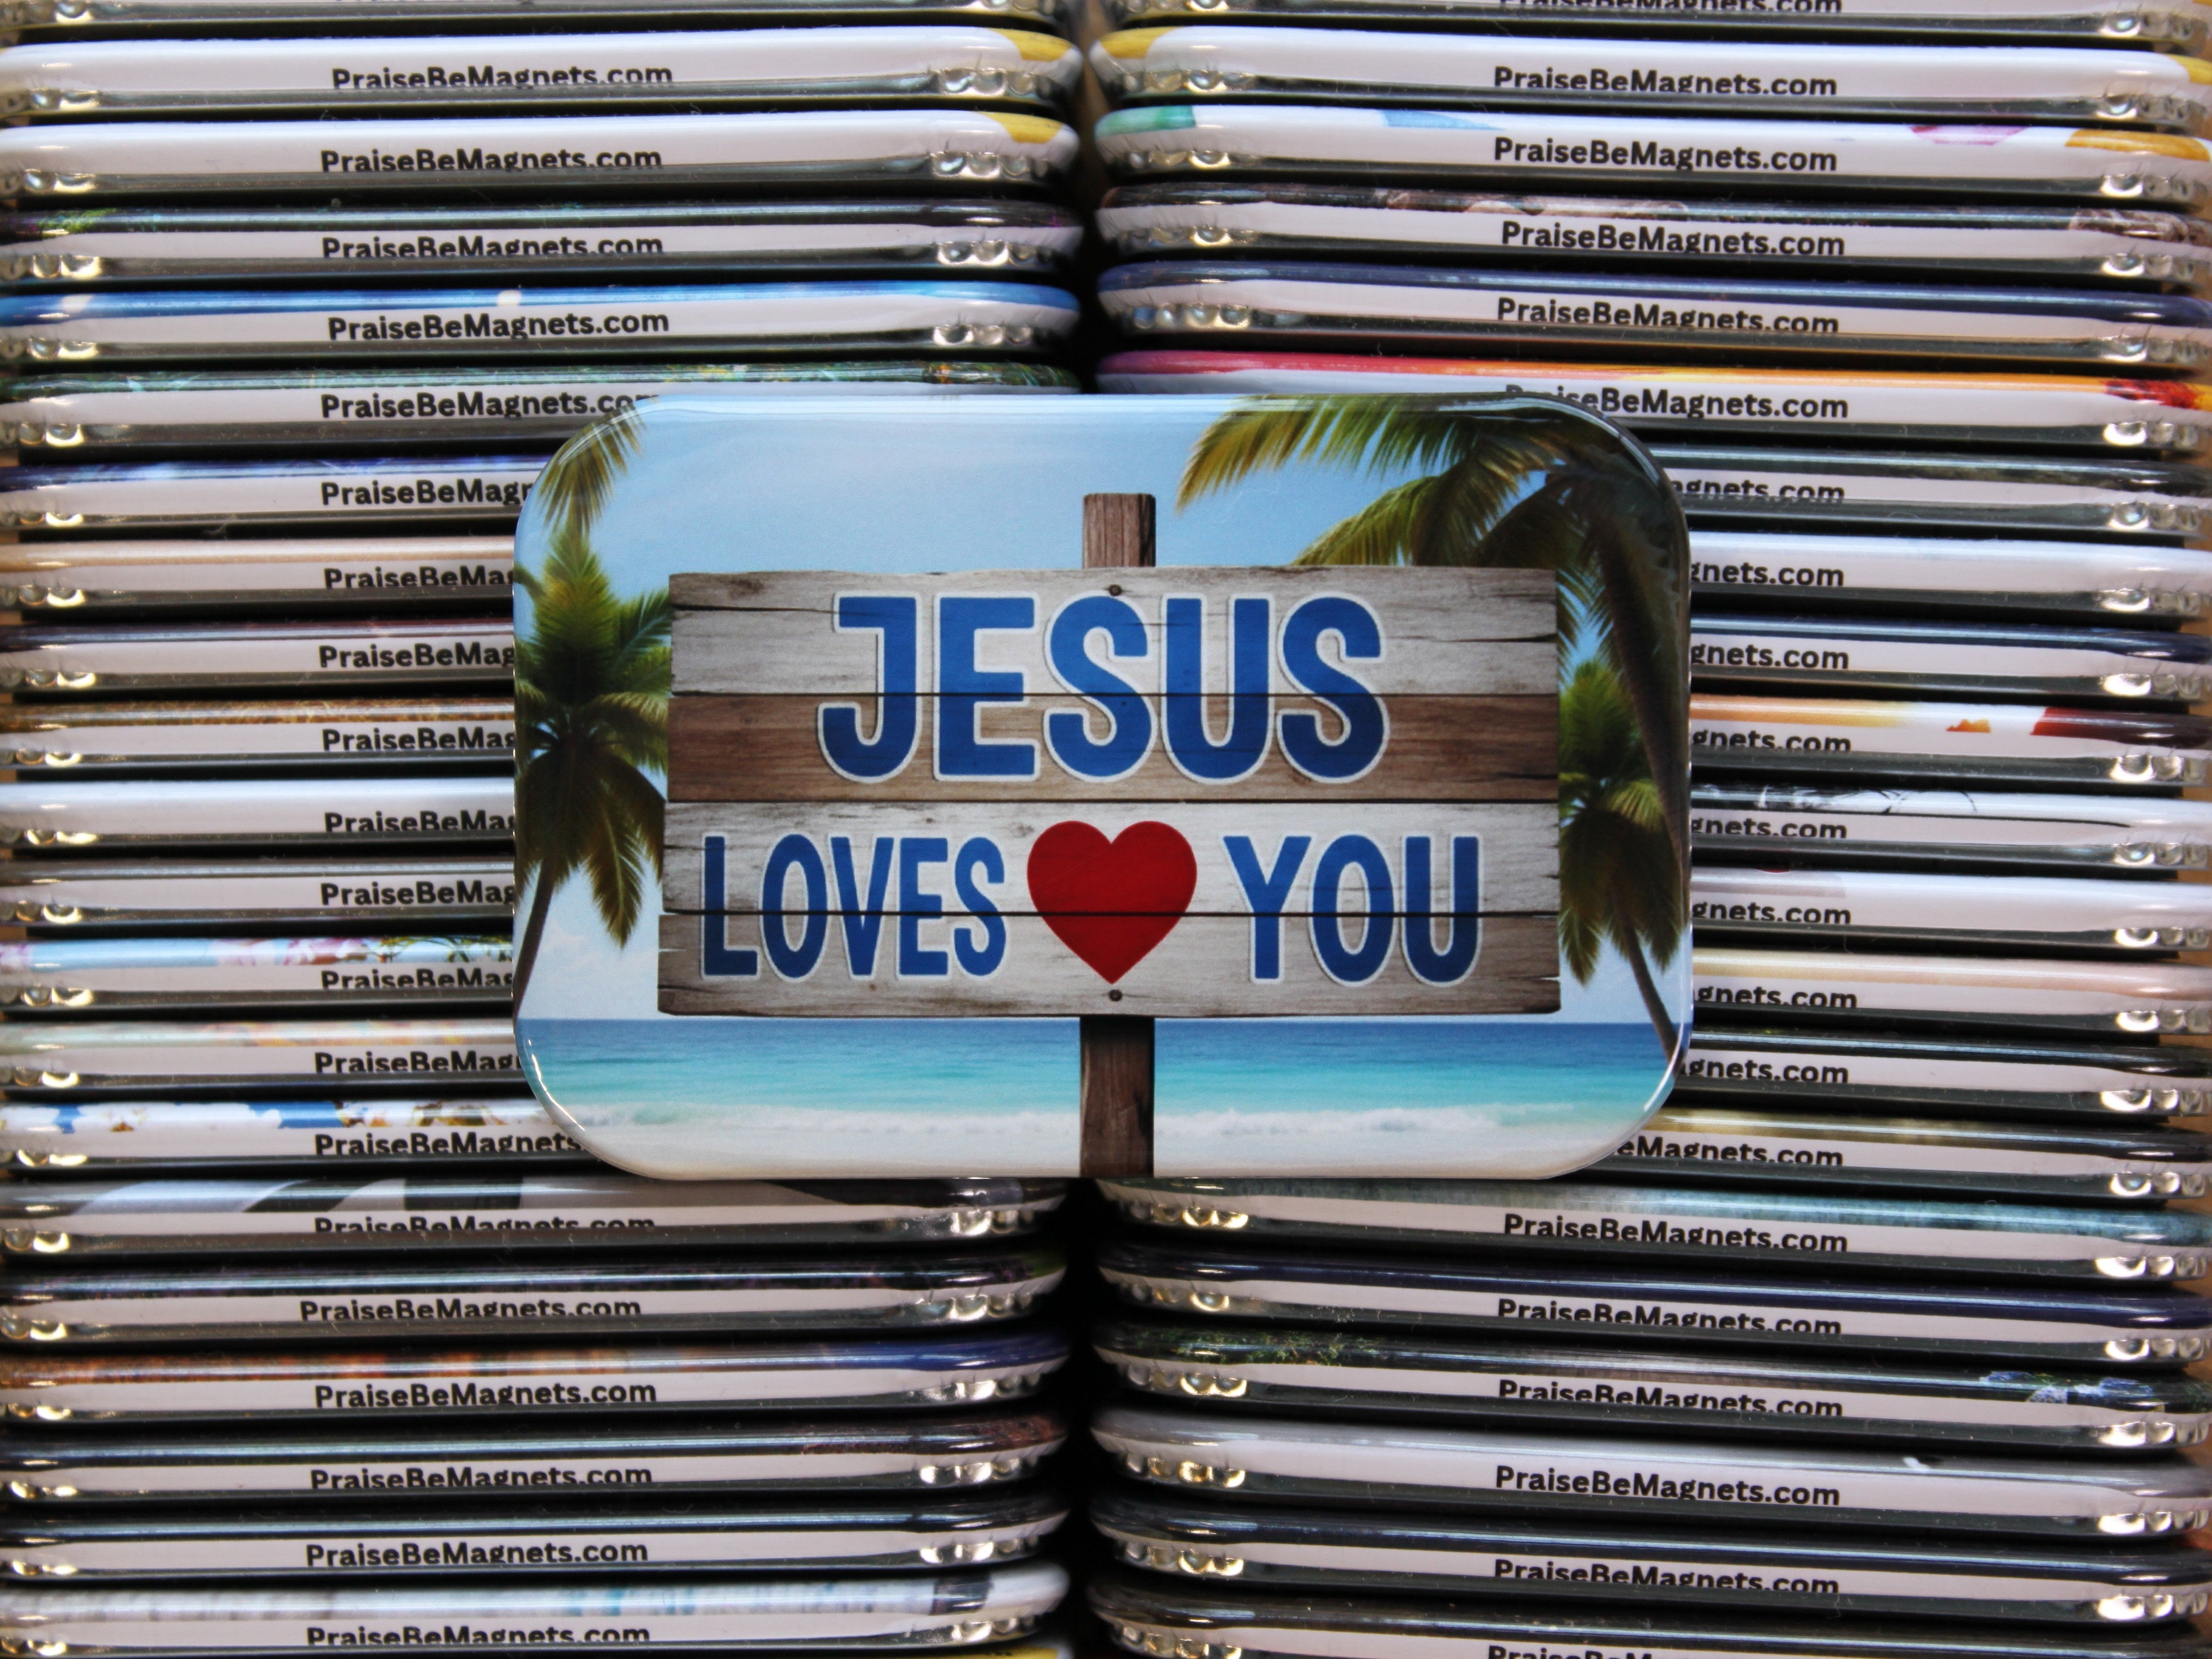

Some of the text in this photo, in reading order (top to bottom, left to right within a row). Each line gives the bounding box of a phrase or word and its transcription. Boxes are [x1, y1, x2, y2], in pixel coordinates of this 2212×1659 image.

[1494, 66, 1838, 95] PraiseBeMagnets.com
[320, 148, 662, 172] PraiseBeMagnets.com
[1494, 137, 1838, 172] PraiseBeMagnets.com
[1502, 220, 1845, 256] PraiseBeMagnets.com
[328, 313, 670, 340] PraiseBeMagnets.com
[1497, 297, 1840, 334] PraiseBeMagnets.com
[321, 392, 659, 418] PraiseBeMagnets.co
[820, 593, 1388, 782] JESUS
[703, 833, 1481, 985] LOVES YOU
[1503, 1213, 1848, 1253] PraiseBeMagnets.com
[300, 1298, 641, 1322] PraiseBeMagnets.com
[315, 1382, 656, 1408] PraiseBeMagnets.com
[1496, 1465, 1840, 1506] PraiseBeMagnets.com
[306, 1542, 648, 1567] PraiseBeMagnets.com
